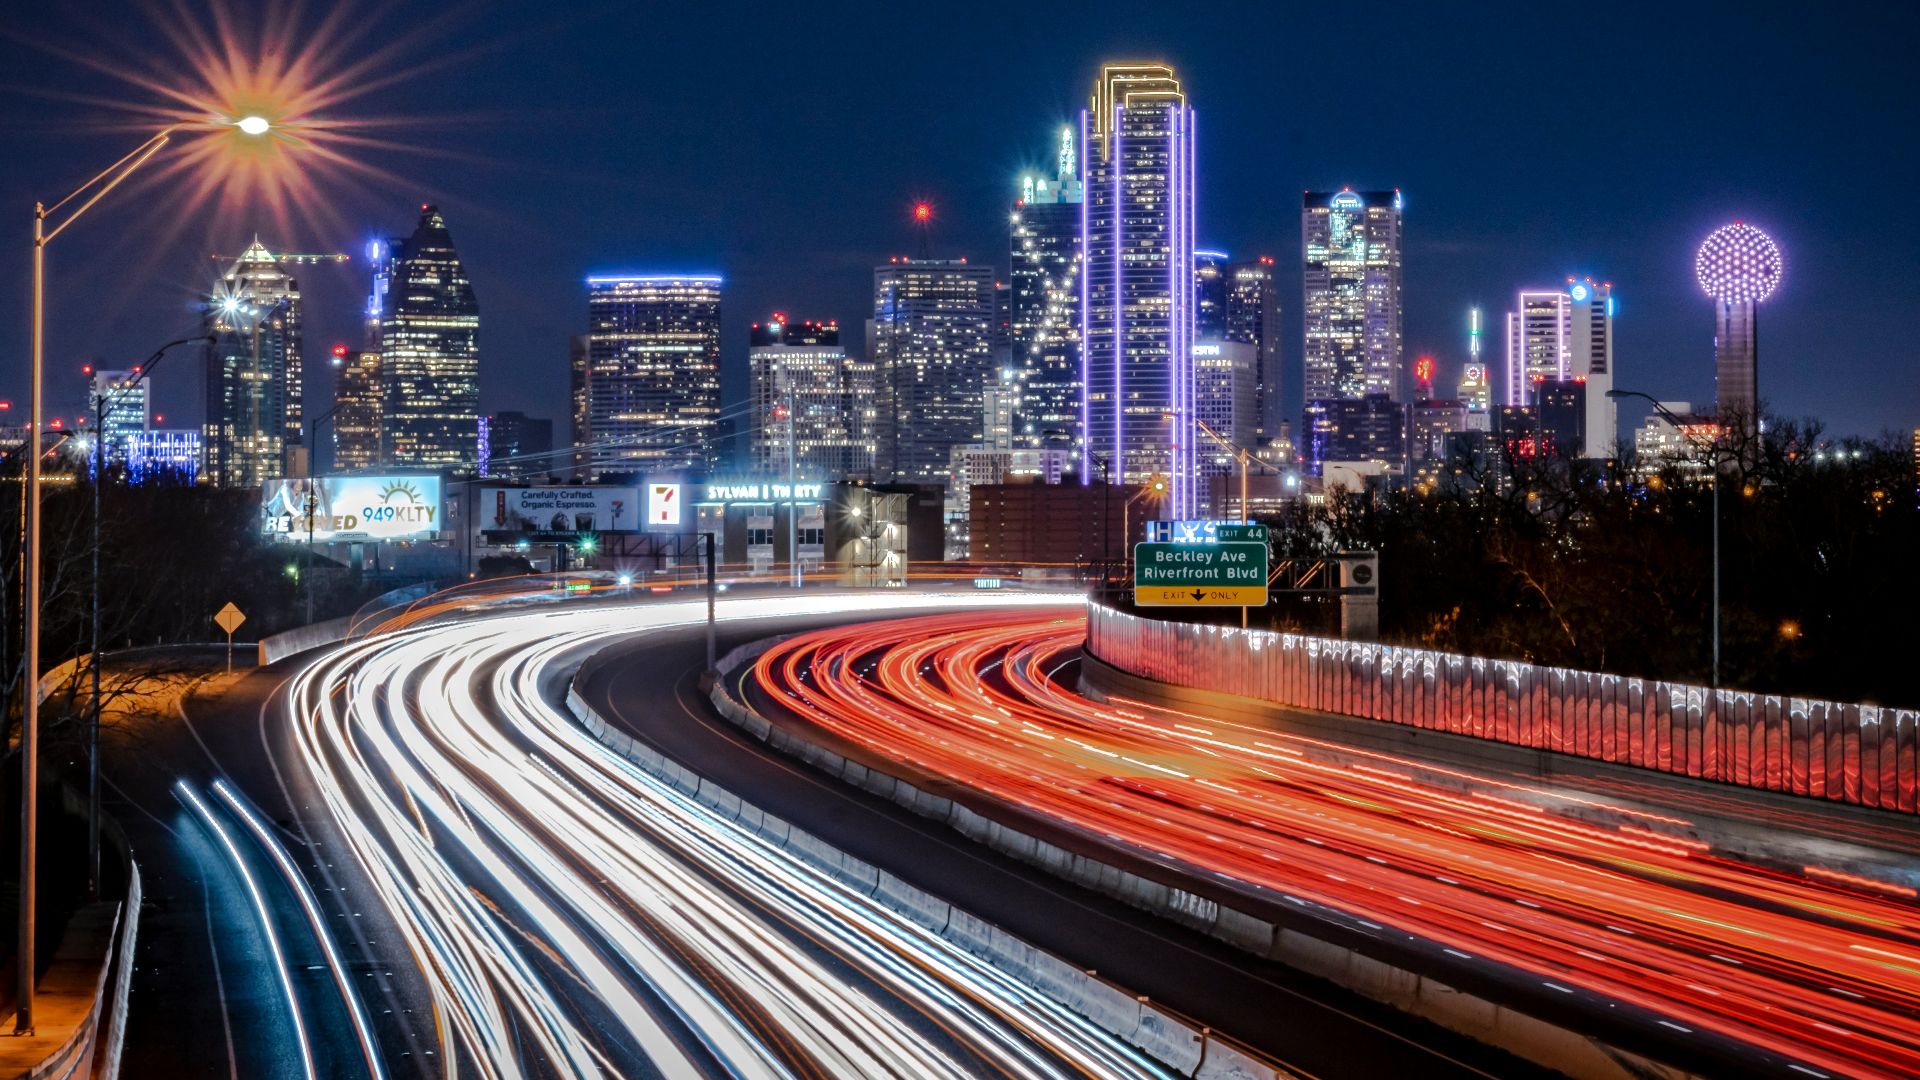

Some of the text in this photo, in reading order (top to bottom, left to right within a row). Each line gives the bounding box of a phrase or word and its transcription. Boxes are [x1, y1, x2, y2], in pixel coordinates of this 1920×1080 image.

[521, 491, 594, 501] Carefully Crafted.
[708, 485, 759, 499] SYLVAN
[772, 484, 821, 498] THRTY
[521, 501, 597, 510] Organic Espresso.
[1219, 529, 1263, 539] EXIT 44
[1155, 551, 1247, 563] Beckley Ave
[1144, 567, 1258, 579] Riverfront Blvd
[1163, 591, 1239, 600] EXIT ONLY
